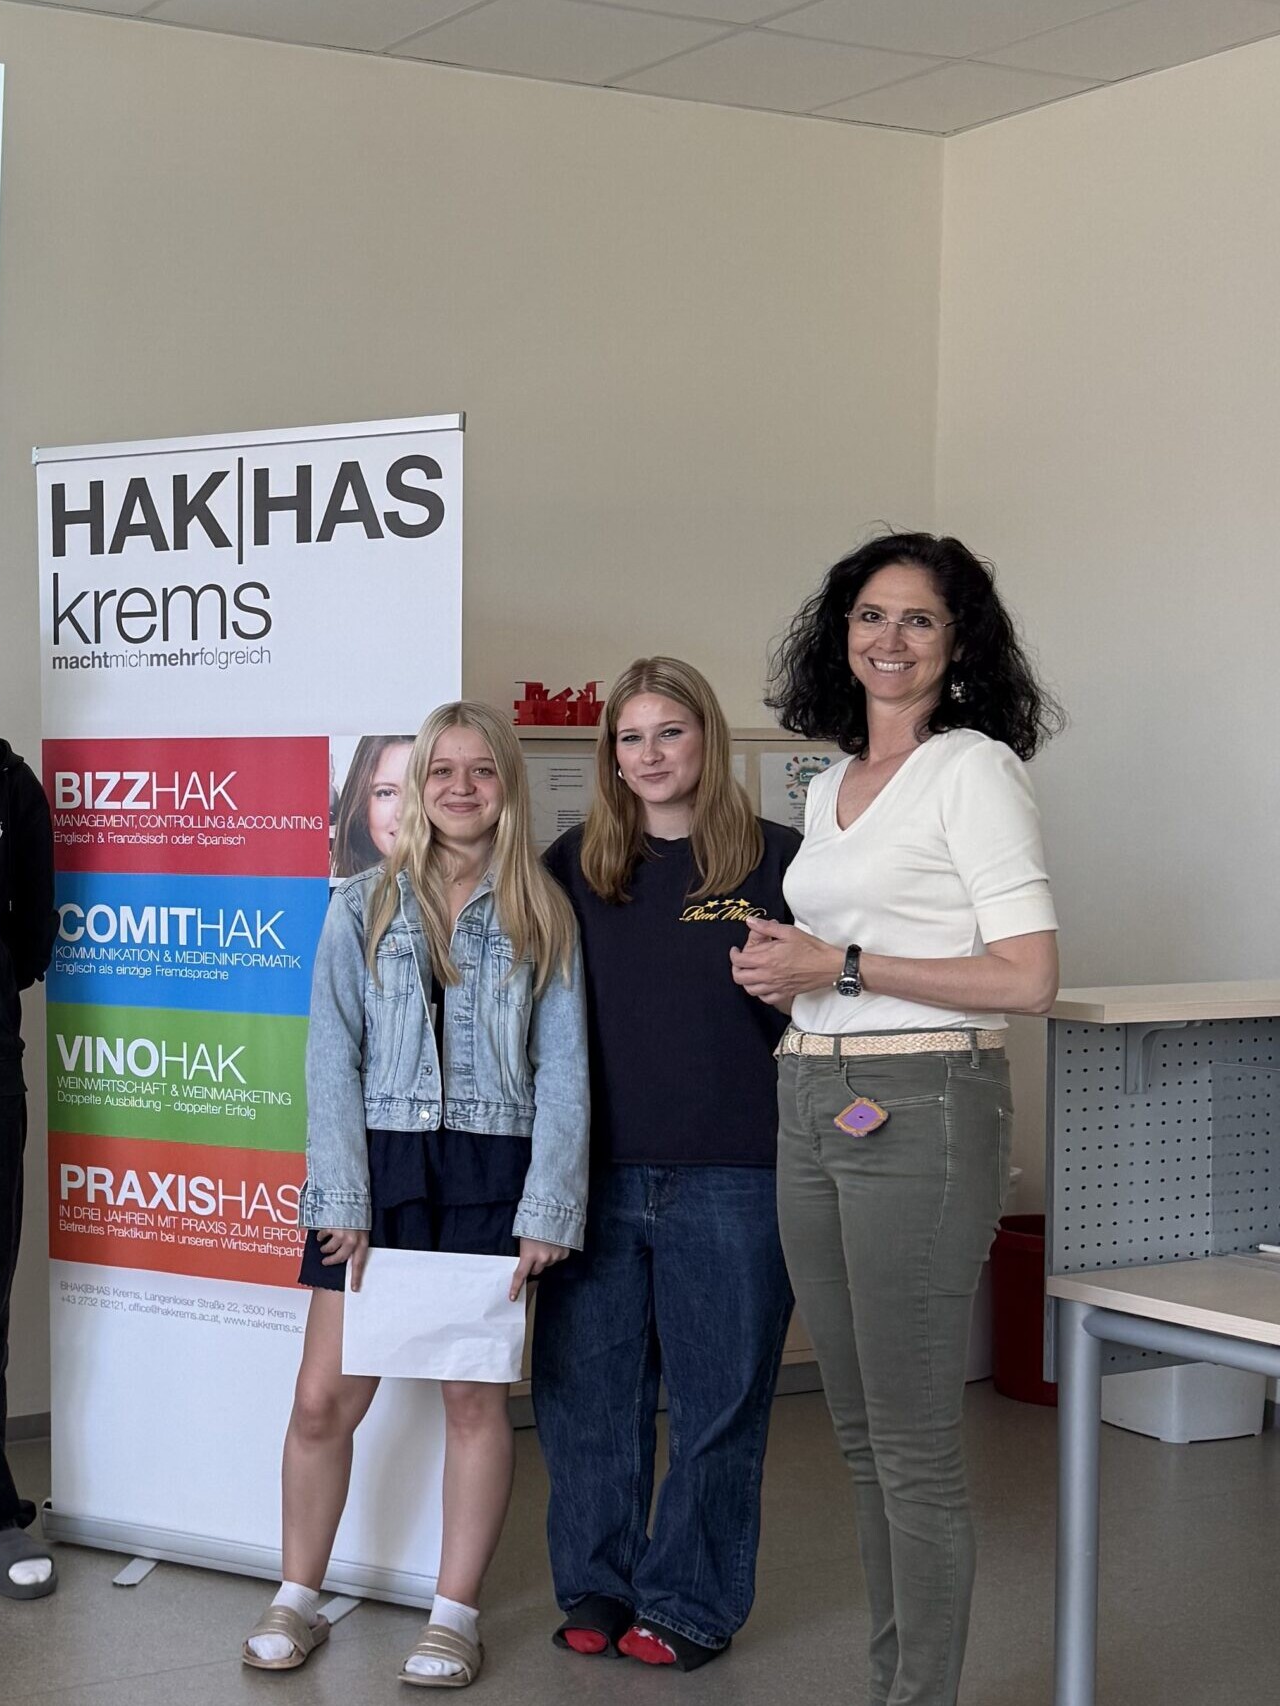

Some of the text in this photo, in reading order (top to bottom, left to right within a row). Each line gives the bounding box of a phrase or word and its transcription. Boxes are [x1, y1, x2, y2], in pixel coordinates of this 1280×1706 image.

[52, 572, 272, 646] krems
[52, 646, 271, 670] machtmichmehrfolgreich
[55, 771, 238, 811] BIZZHAK
[54, 814, 322, 830] MANAGEMENT, CONTROLLING & ACCOUNTING
[54, 832, 246, 848] Englisch & Französisch oder Spanisch
[58, 903, 285, 950] COMITHAK
[55, 946, 301, 969] KOMMUNIKATION & MEDIENINFORMATIK
[55, 961, 229, 981] Englisch als einzige Fremdsprache
[56, 1033, 247, 1084] VINOHAK
[57, 1076, 291, 1106] WEINWIRTSCHAFT & WEINMARKETING
[57, 1090, 102, 1106] Doppelte
[104, 1094, 162, 1112] Ausbildung
[173, 1100, 222, 1116] doppelter
[225, 1104, 256, 1120] Erfolg
[59, 1163, 300, 1225] PRAXISHAS
[59, 1204, 308, 1244] IN DREI JAHREN MIT PRAXIS ZUM ERFOL
[59, 1219, 105, 1236] Betreutes
[107, 1224, 157, 1242] Praktikum
[160, 1229, 176, 1243] bei
[177, 1233, 218, 1249] unseren
[78, 1296, 99, 1308] 2732
[197, 1297, 225, 1312] Straße
[242, 1304, 265, 1317] 3500
[267, 1307, 296, 1320] Krems
